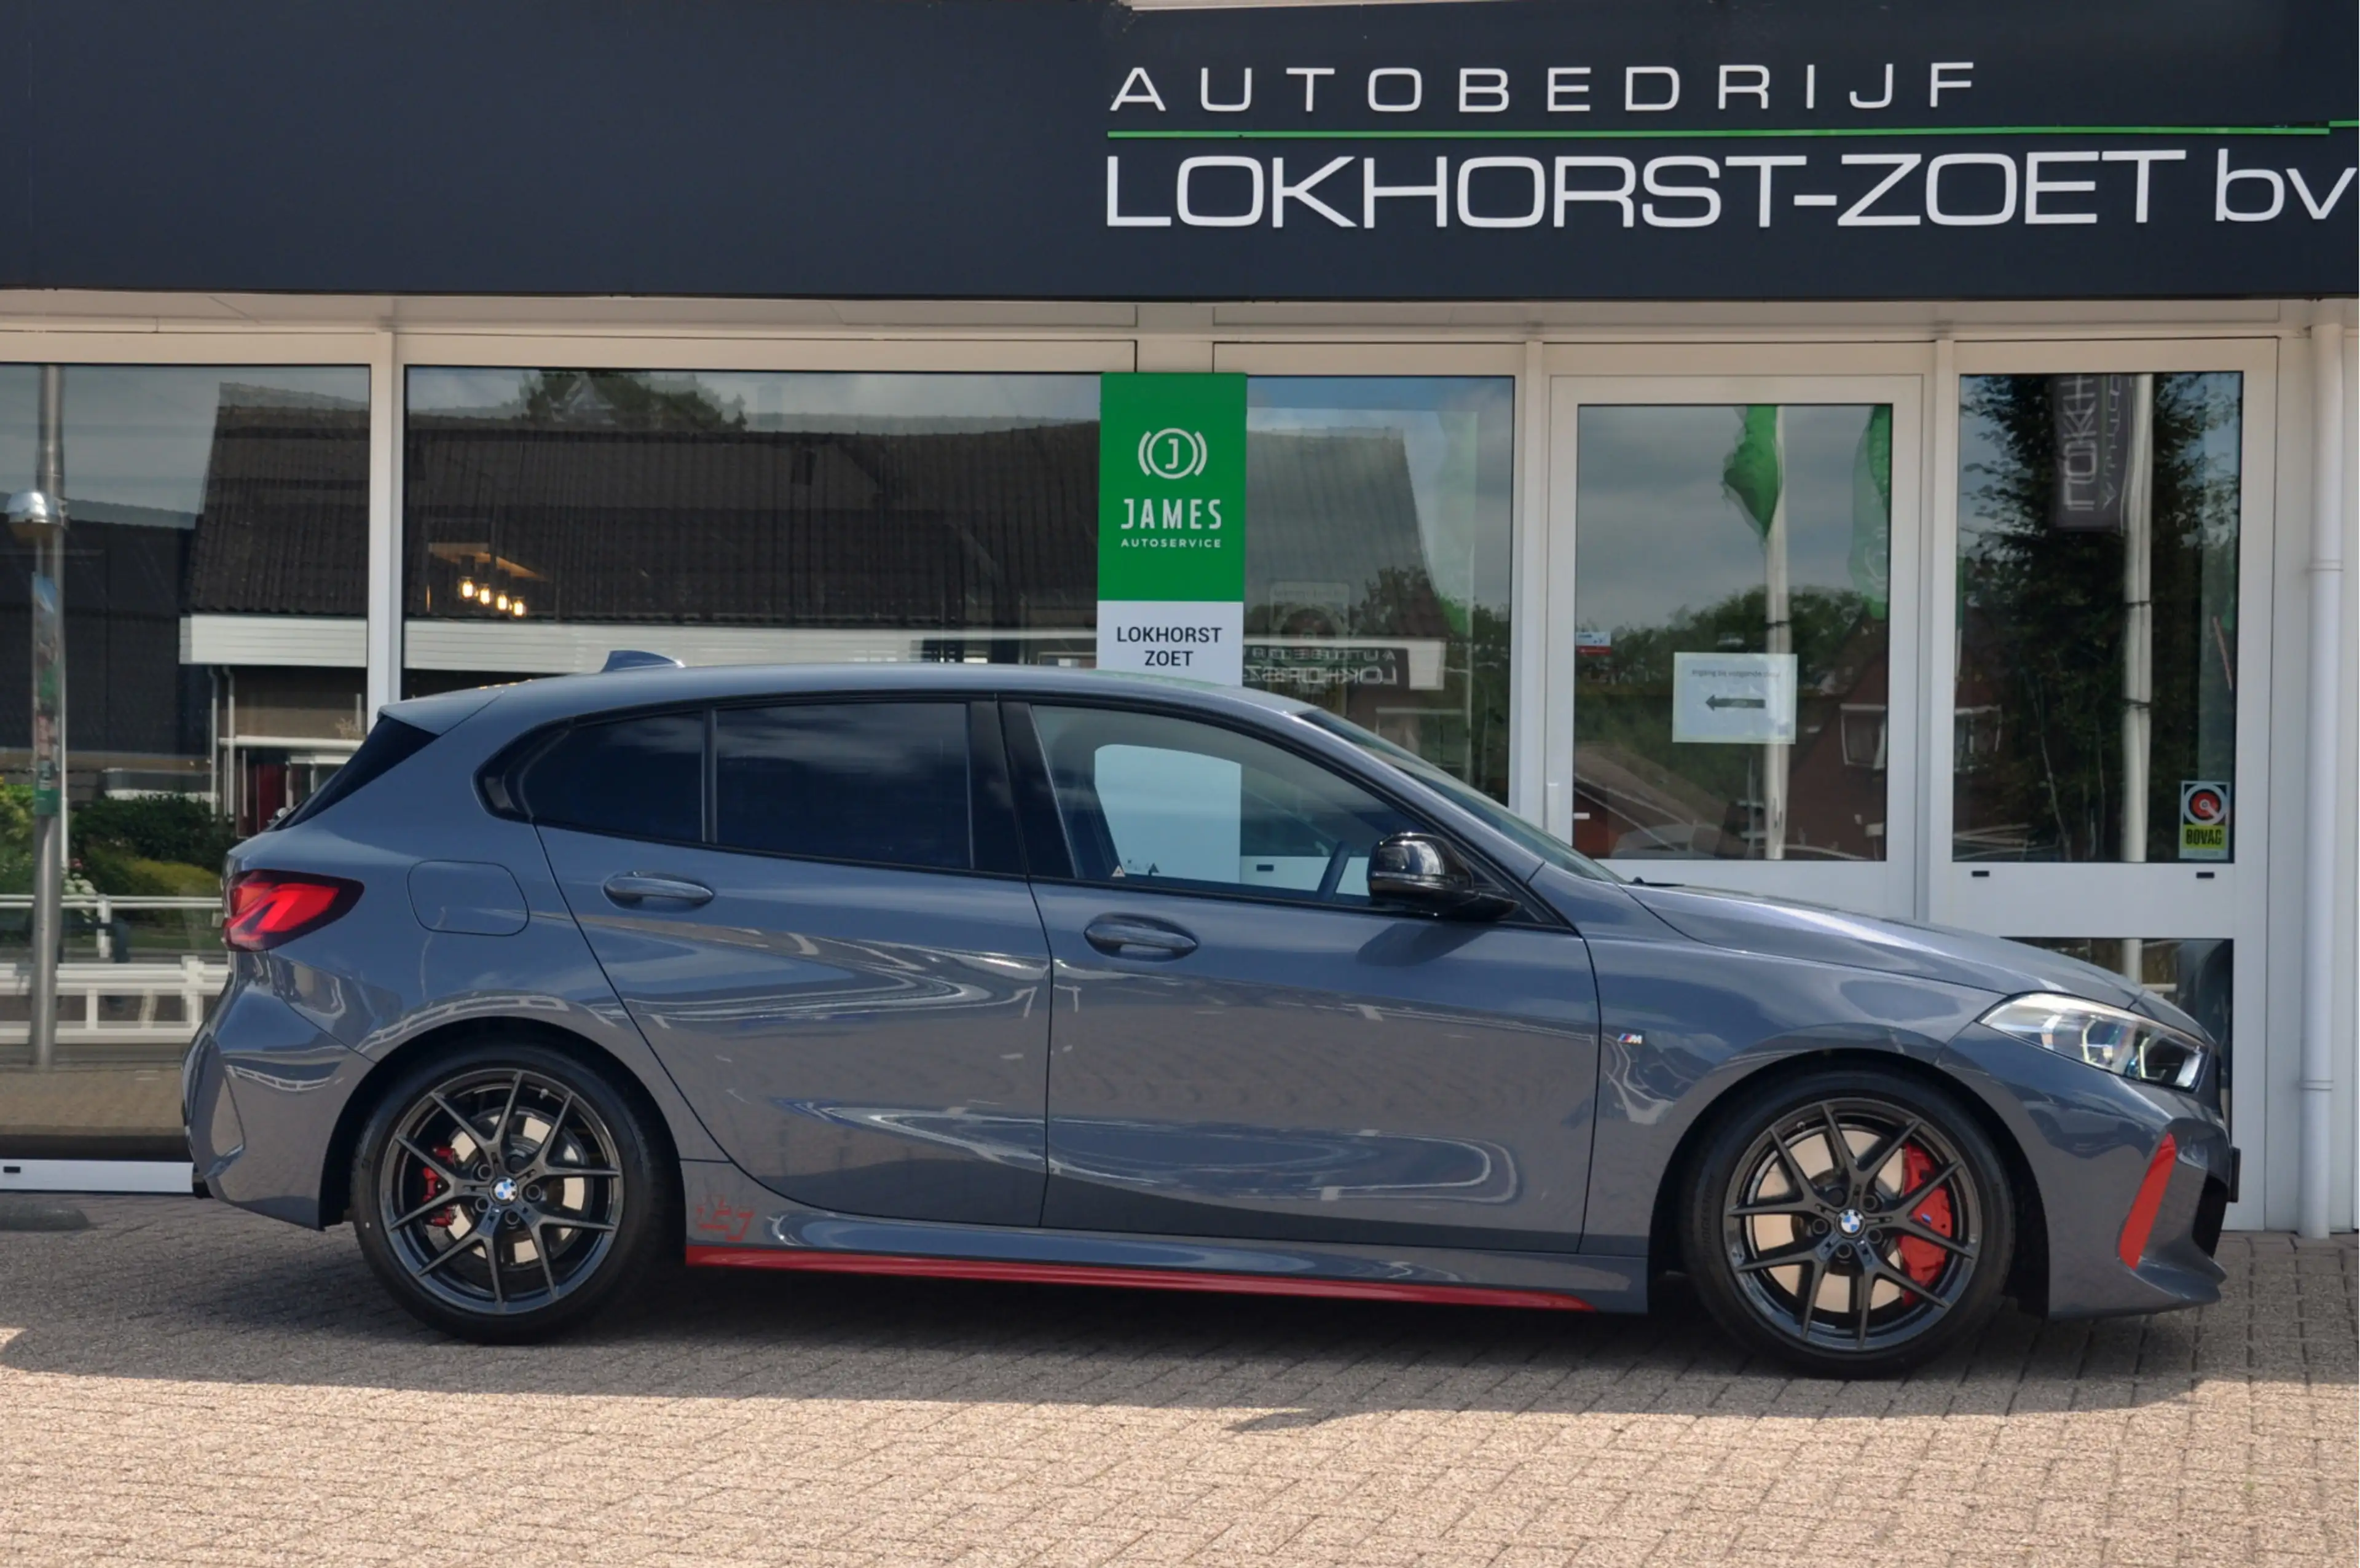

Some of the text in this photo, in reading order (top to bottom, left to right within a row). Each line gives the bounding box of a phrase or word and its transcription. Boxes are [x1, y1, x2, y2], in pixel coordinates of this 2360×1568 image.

[1109, 61, 1974, 113] AUTOBEDRIJF
[1107, 147, 2358, 229] LOKHORST-ZOET bv
[1120, 498, 1222, 530] JAMES
[1120, 538, 1222, 549] AUTOSERVICE
[1117, 626, 1222, 643] LOKHORST
[1144, 649, 1195, 667] ZOET
[2185, 828, 2222, 845] BOVAG
